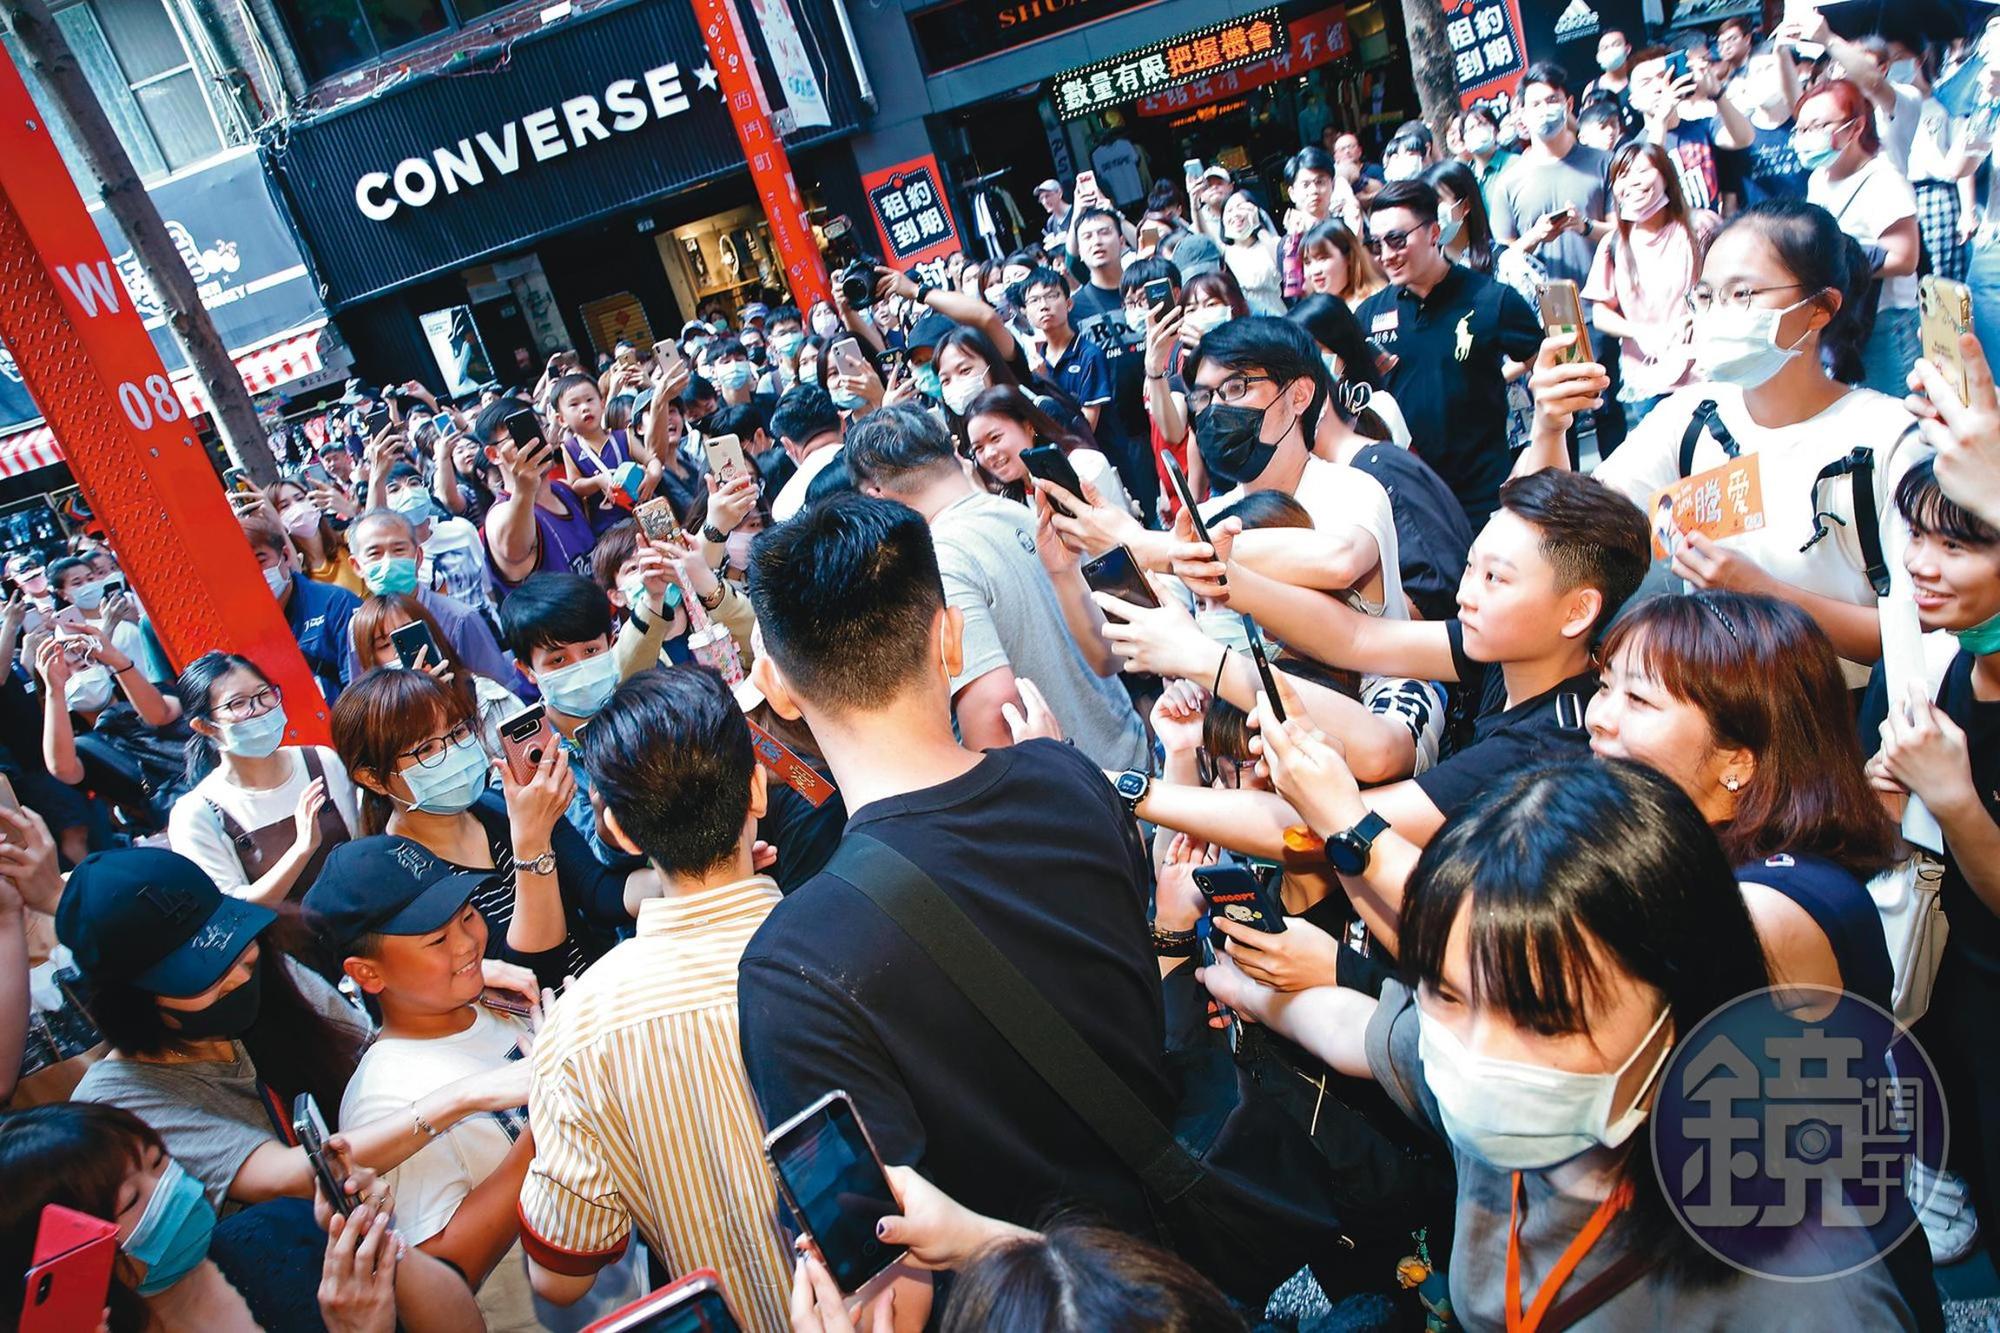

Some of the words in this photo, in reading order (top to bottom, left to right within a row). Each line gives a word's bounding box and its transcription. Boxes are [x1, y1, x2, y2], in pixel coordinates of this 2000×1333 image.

[1447, 4, 1504, 52] 租約
[1554, 11, 1599, 35] adidas
[1060, 20, 1274, 112] 數量有限把握機會
[1456, 34, 1514, 84] 到期
[355, 61, 691, 222] CONVERSE
[733, 89, 774, 173] 西門町
[880, 180, 932, 220] 租約
[891, 206, 945, 250] 到期
[56, 261, 120, 318] W
[1373, 329, 1398, 346] USA
[118, 374, 181, 431] 08
[1211, 891, 1257, 903] SNOOPY
